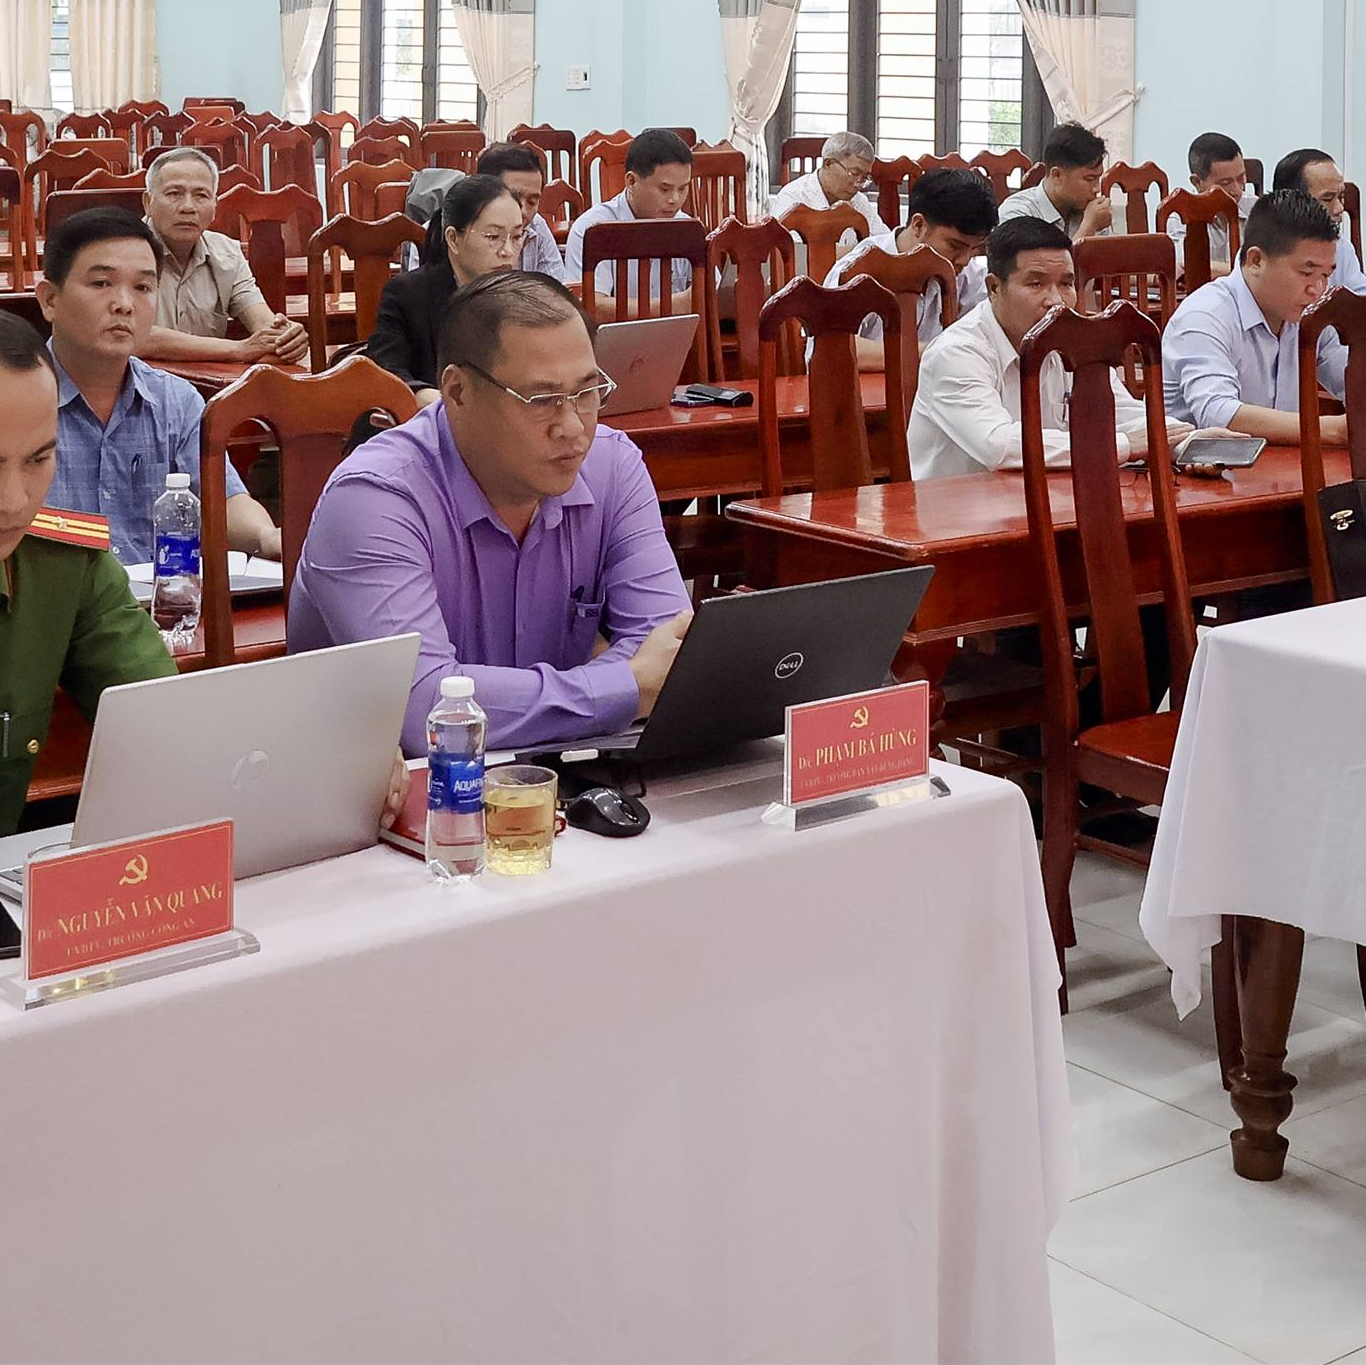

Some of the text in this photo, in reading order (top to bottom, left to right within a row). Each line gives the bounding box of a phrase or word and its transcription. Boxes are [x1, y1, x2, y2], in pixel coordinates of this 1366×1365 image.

[816, 741, 854, 767] PHẠM
[58, 898, 126, 935] NGUYỄN
[167, 881, 223, 914] QUANG
